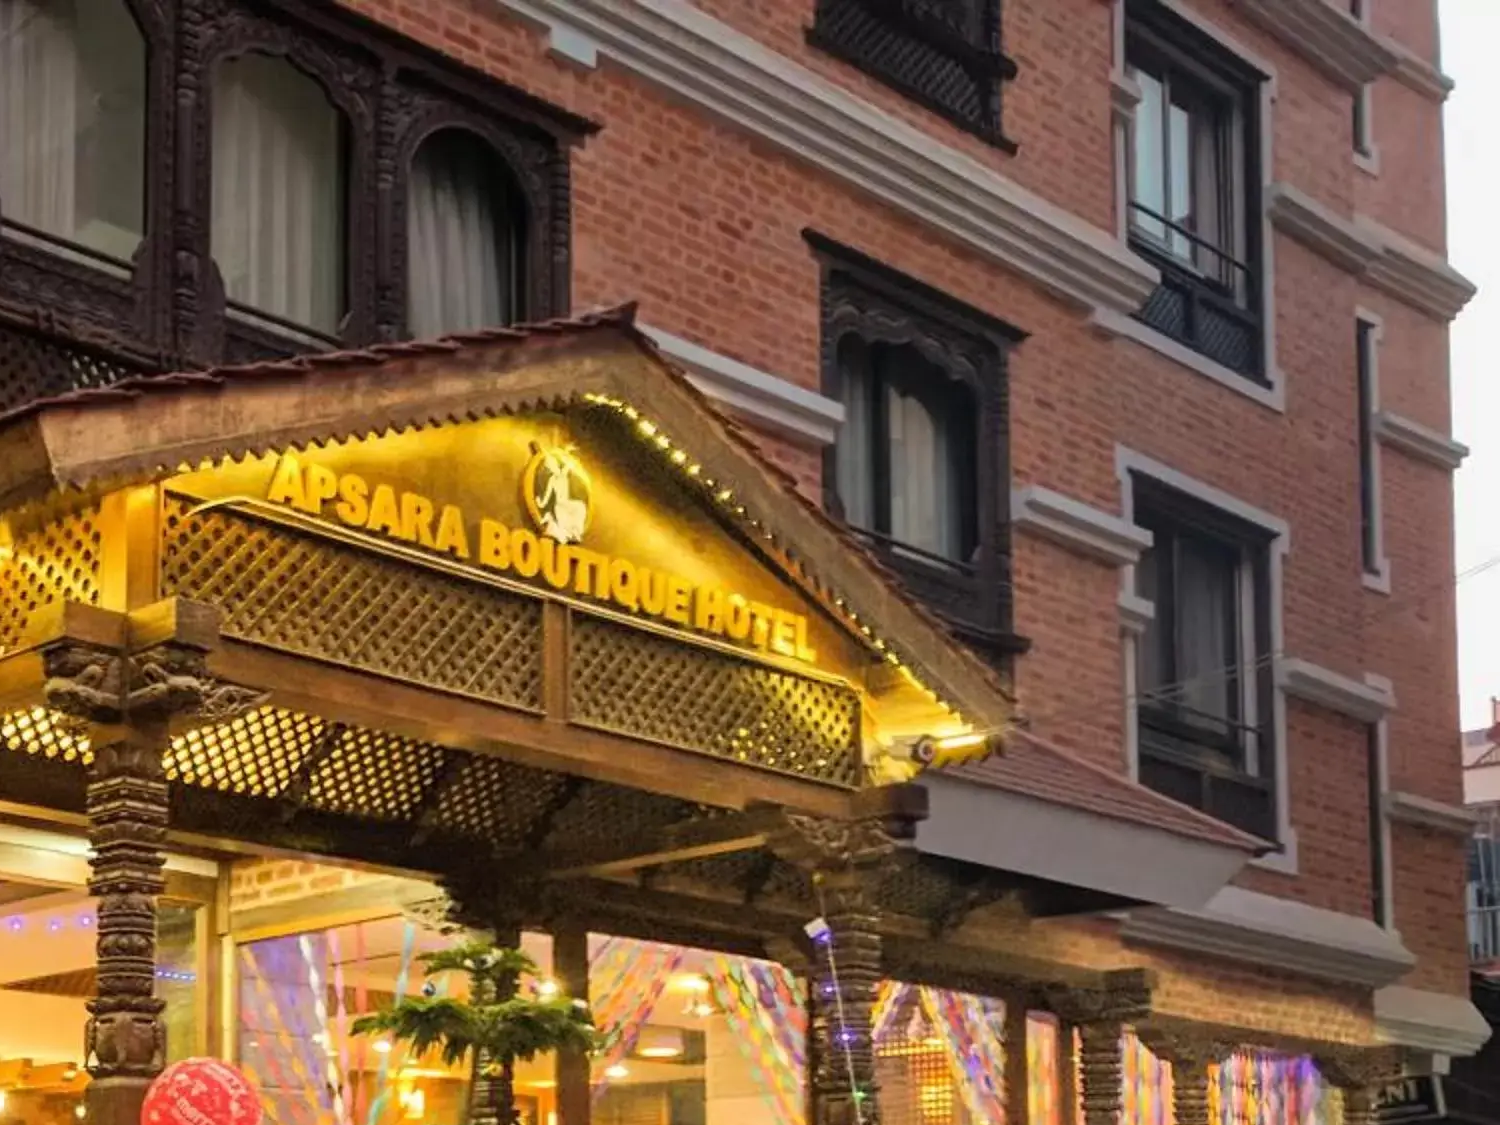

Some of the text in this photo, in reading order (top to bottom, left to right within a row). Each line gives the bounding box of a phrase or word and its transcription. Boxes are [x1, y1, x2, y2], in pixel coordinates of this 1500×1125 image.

[267, 453, 817, 662] APSARA BOUTIQUE HOTEL
